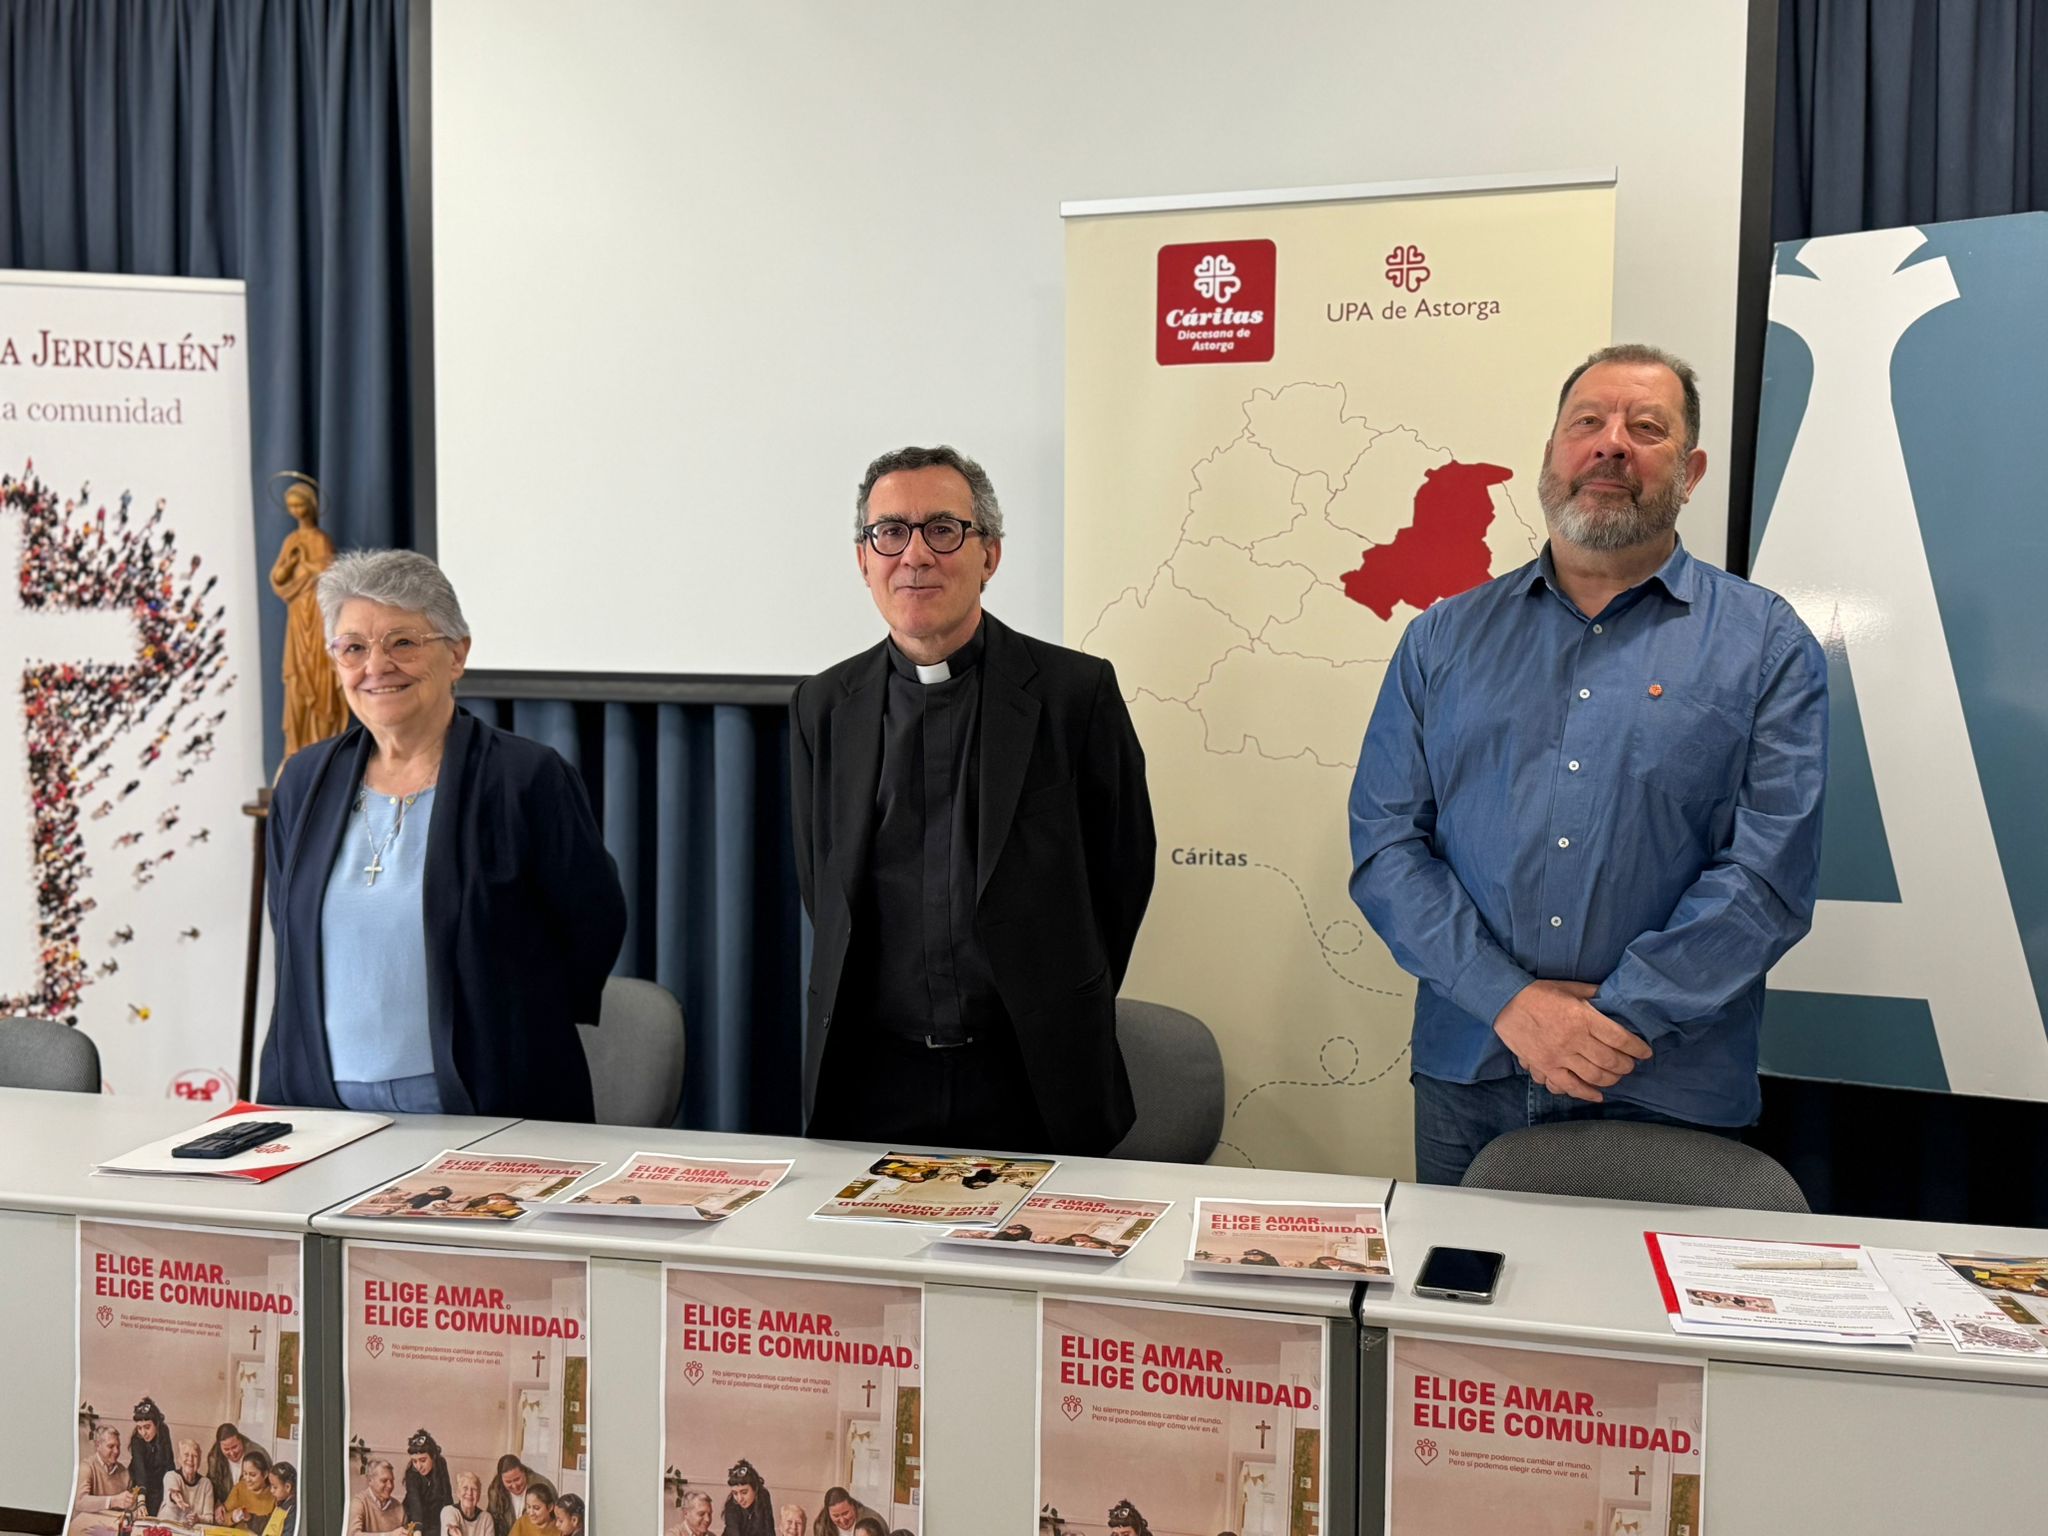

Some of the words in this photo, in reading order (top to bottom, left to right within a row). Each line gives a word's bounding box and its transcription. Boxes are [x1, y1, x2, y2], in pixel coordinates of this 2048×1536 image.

[1166, 307, 1264, 328] Cáritas
[1327, 301, 1374, 322] UPA
[1382, 300, 1408, 320] de
[1415, 297, 1501, 320] Astorga
[1177, 329, 1234, 340] Diocesana
[1236, 328, 1251, 338] de
[0, 337, 21, 366] A
[1192, 341, 1235, 353] Astorga
[2, 401, 18, 421] a
[27, 398, 184, 425] comunidad
[1171, 848, 1248, 867] Cáritas
[437, 1164, 482, 1172] ELIGE
[444, 1159, 490, 1167] ELIGE
[634, 1164, 679, 1174] ELIGE
[627, 1172, 672, 1181] ELIGE
[1211, 1214, 1261, 1223] ELIGE
[1211, 1222, 1261, 1231] ELIGE
[96, 1253, 153, 1277] ELIGE
[159, 1260, 230, 1285] AMAR.
[96, 1276, 154, 1300] ELIGE
[160, 1283, 298, 1316] COMUNIDAD.
[364, 1280, 428, 1304] ELIGE
[434, 1285, 511, 1310] AMAR.
[364, 1304, 428, 1328] ELIGE
[435, 1309, 585, 1340] COMUNIDAD.
[684, 1303, 751, 1329] ELIGE
[758, 1310, 840, 1337] AMAR.
[683, 1329, 751, 1354] ELIGE
[758, 1335, 919, 1370] COMUNIDAD.
[1061, 1335, 1135, 1363] ELIGE
[1141, 1344, 1232, 1374] AMAR.
[1061, 1361, 1135, 1390] ELIGE
[1142, 1370, 1319, 1411] COMUNIDAD.
[1414, 1375, 1496, 1406] ELIGE
[1503, 1385, 1603, 1417] AMAR.
[1092, 1404, 1102, 1412] No
[1103, 1406, 1130, 1415] siempre
[1130, 1409, 1162, 1418] podemos
[1162, 1413, 1189, 1422] cambiar
[1092, 1414, 1107, 1422] Pero
[1114, 1416, 1146, 1426] podemos
[1148, 1420, 1166, 1429] elegir
[1166, 1422, 1186, 1430] cómo
[1414, 1403, 1495, 1433] ELIGE
[1504, 1412, 1699, 1456] COMUNIDAD.
[1448, 1448, 1459, 1456] No
[1460, 1450, 1490, 1460] siempre
[1490, 1454, 1526, 1463] podemos
[1526, 1458, 1555, 1466] cambiar
[1448, 1458, 1465, 1466] Pero
[1474, 1461, 1508, 1471] podemos
[1509, 1465, 1530, 1474] elegir
[1530, 1468, 1552, 1476] cómo
